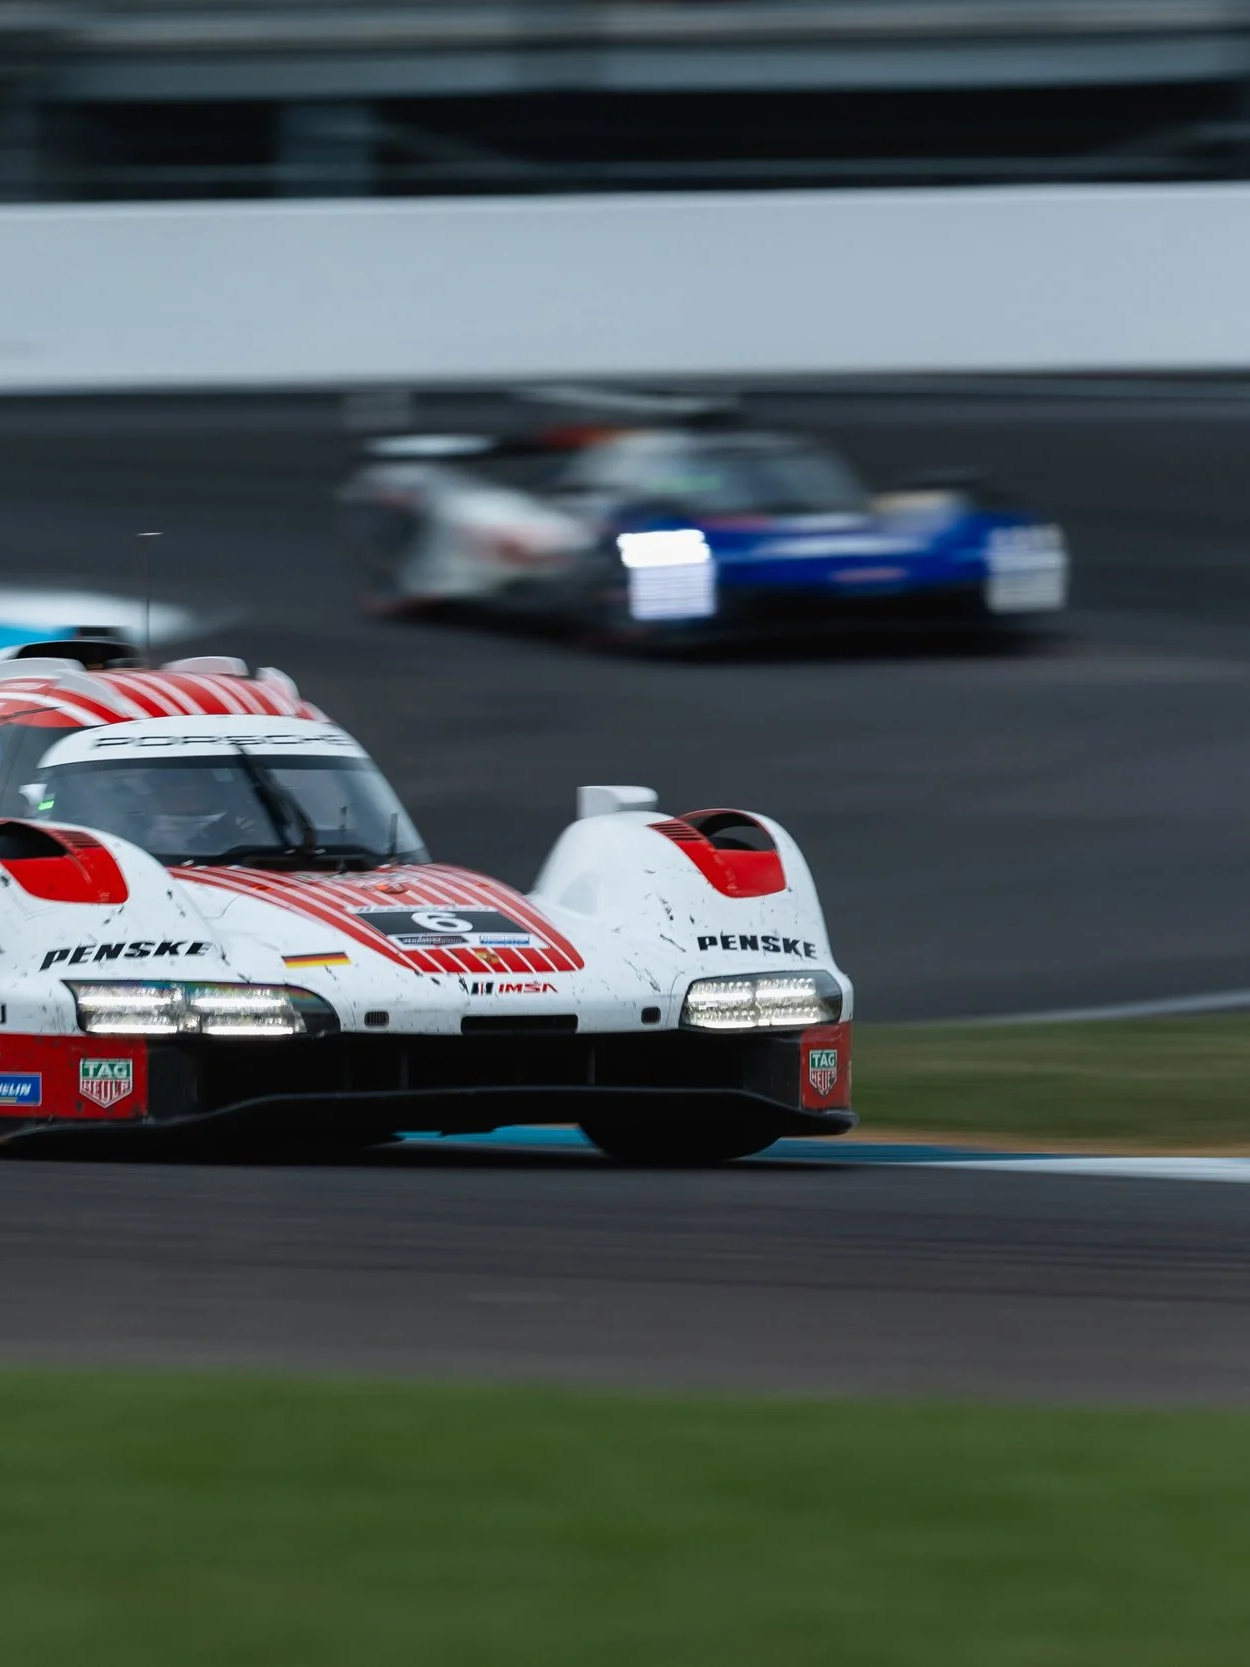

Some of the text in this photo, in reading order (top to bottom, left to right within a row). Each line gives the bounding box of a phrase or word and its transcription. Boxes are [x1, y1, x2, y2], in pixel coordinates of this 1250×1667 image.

[91, 734, 355, 748] PORSCHE
[411, 911, 474, 933] 6
[39, 940, 213, 972] PENSKE
[697, 934, 817, 960] PENSKE
[499, 982, 558, 994] IMSA
[83, 1061, 128, 1079] TAG
[812, 1053, 836, 1068] TAG
[82, 1080, 130, 1104] HEUER
